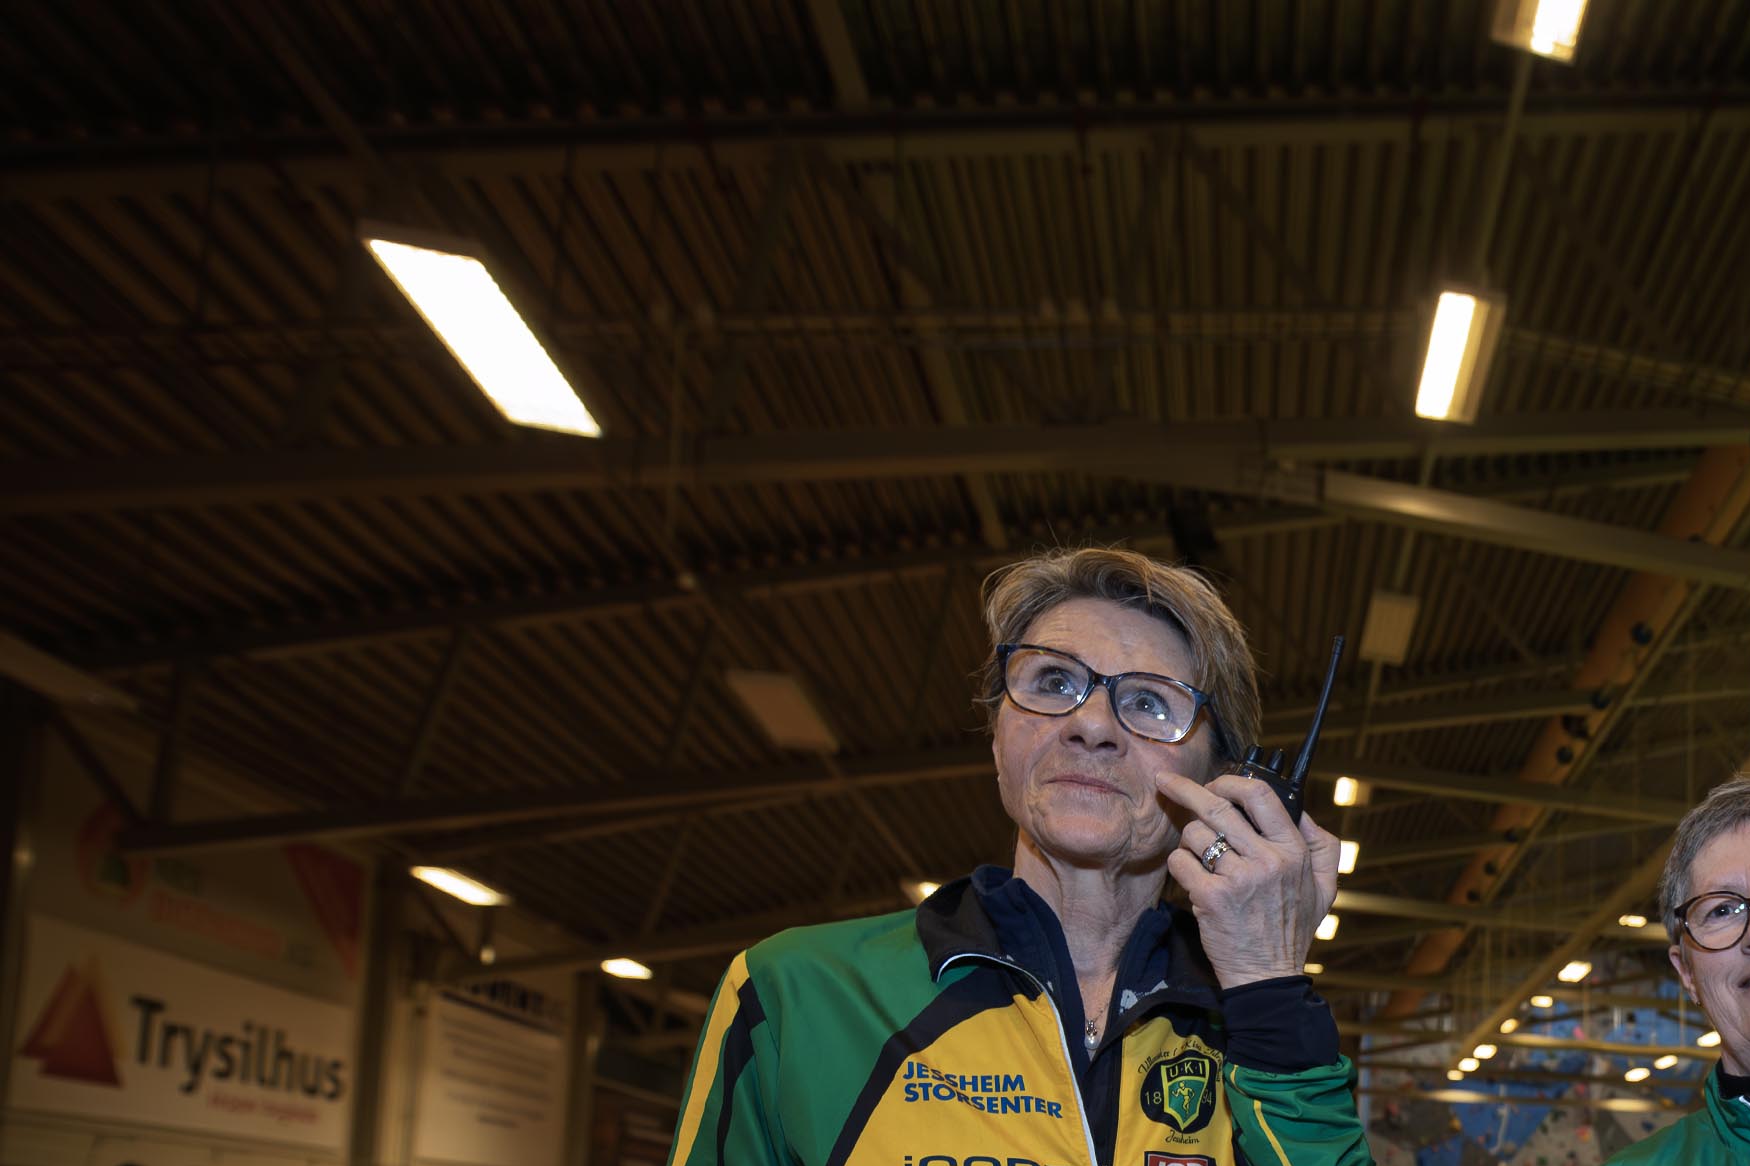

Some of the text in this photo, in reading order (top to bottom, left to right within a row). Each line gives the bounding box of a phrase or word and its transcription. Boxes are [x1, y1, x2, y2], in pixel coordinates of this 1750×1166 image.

[131, 994, 346, 1102] Trysilhus
[903, 1061, 1026, 1093] JESSHEIM
[904, 1082, 1063, 1119] STORSENTER
[1144, 1091, 1162, 1105] 18
